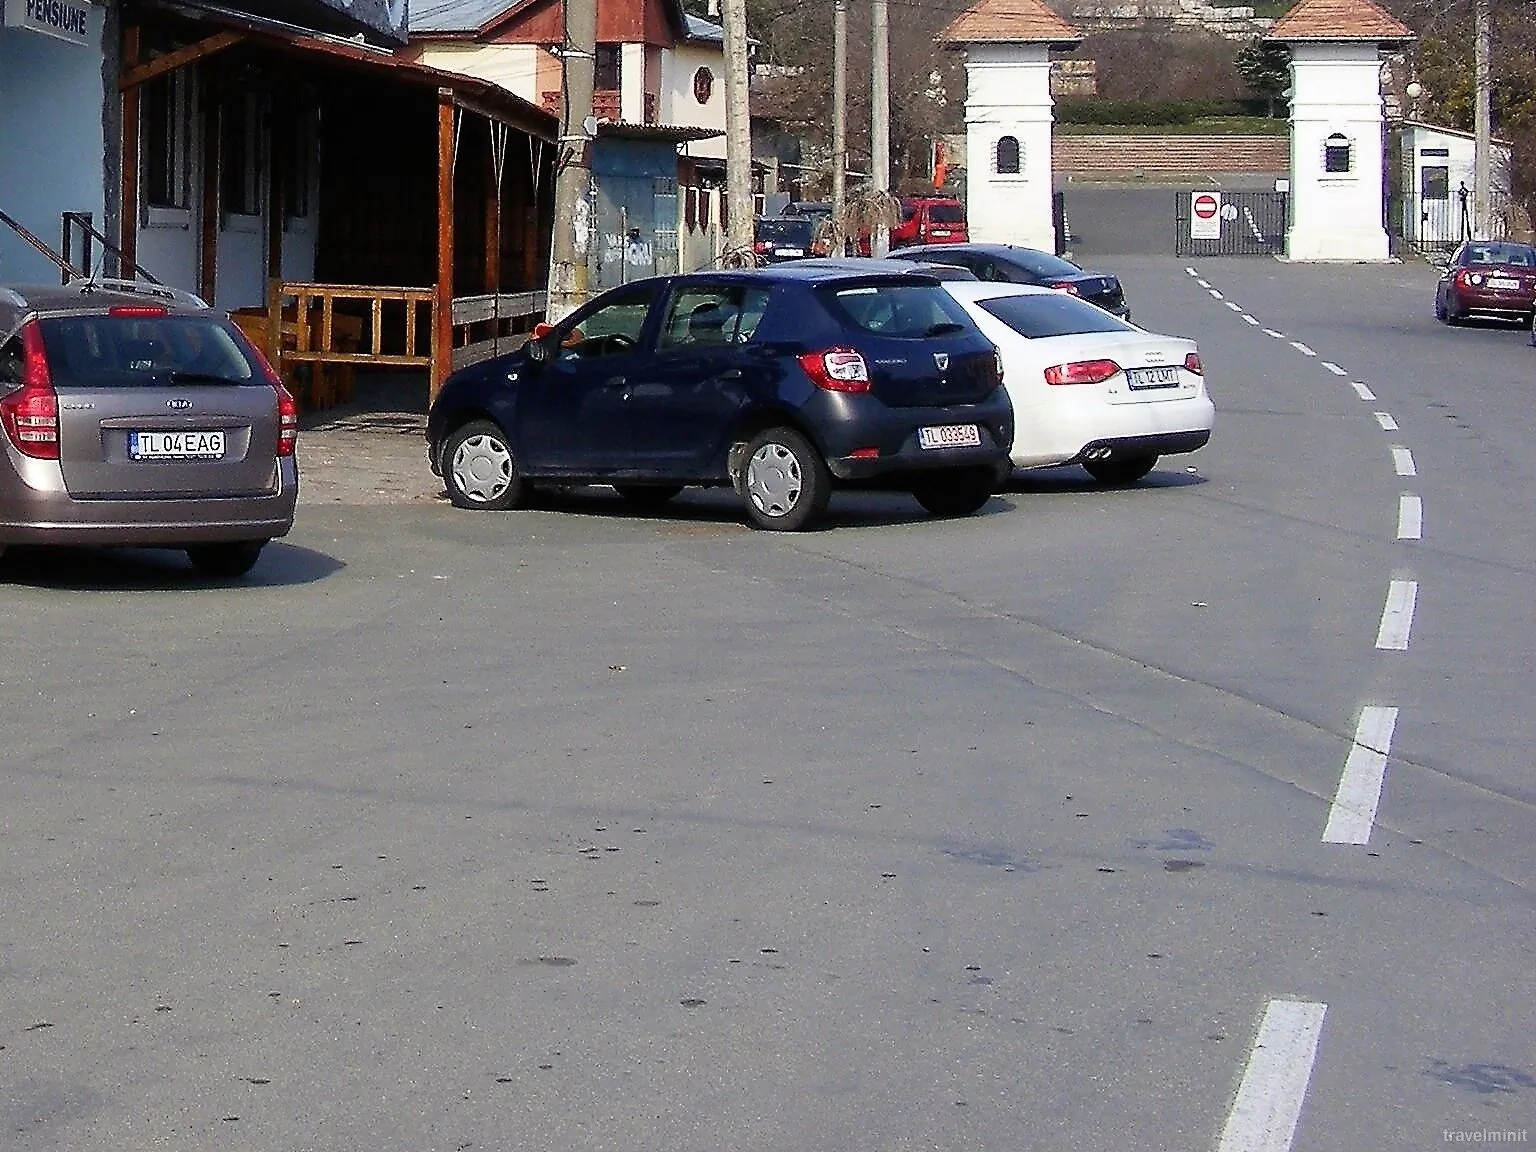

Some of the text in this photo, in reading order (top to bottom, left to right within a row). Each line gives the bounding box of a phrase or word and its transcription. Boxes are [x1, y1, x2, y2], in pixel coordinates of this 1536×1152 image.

[141, 434, 221, 452] TL 04 EAG
[925, 429, 939, 443] TL
